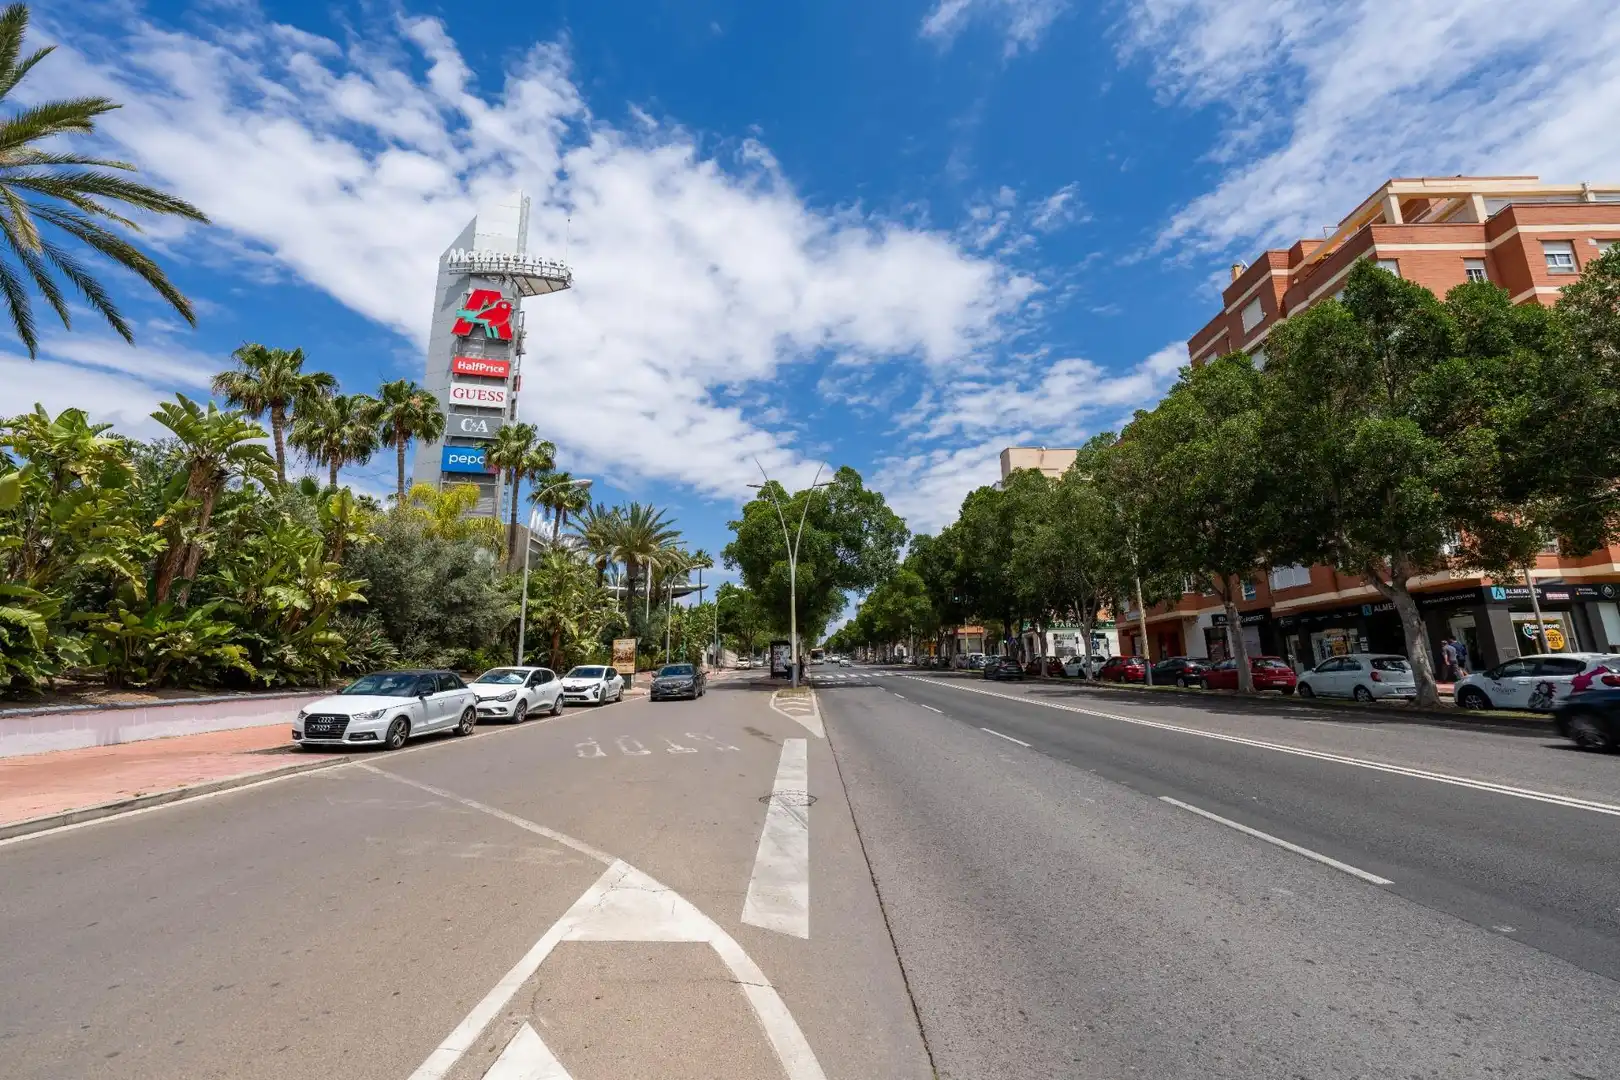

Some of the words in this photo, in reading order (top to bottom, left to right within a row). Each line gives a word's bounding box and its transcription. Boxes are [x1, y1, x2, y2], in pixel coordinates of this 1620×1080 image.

[457, 361, 505, 374] HalfPrice
[453, 387, 504, 403] GUESS
[460, 418, 489, 434] C&A
[448, 453, 485, 466] pepc
